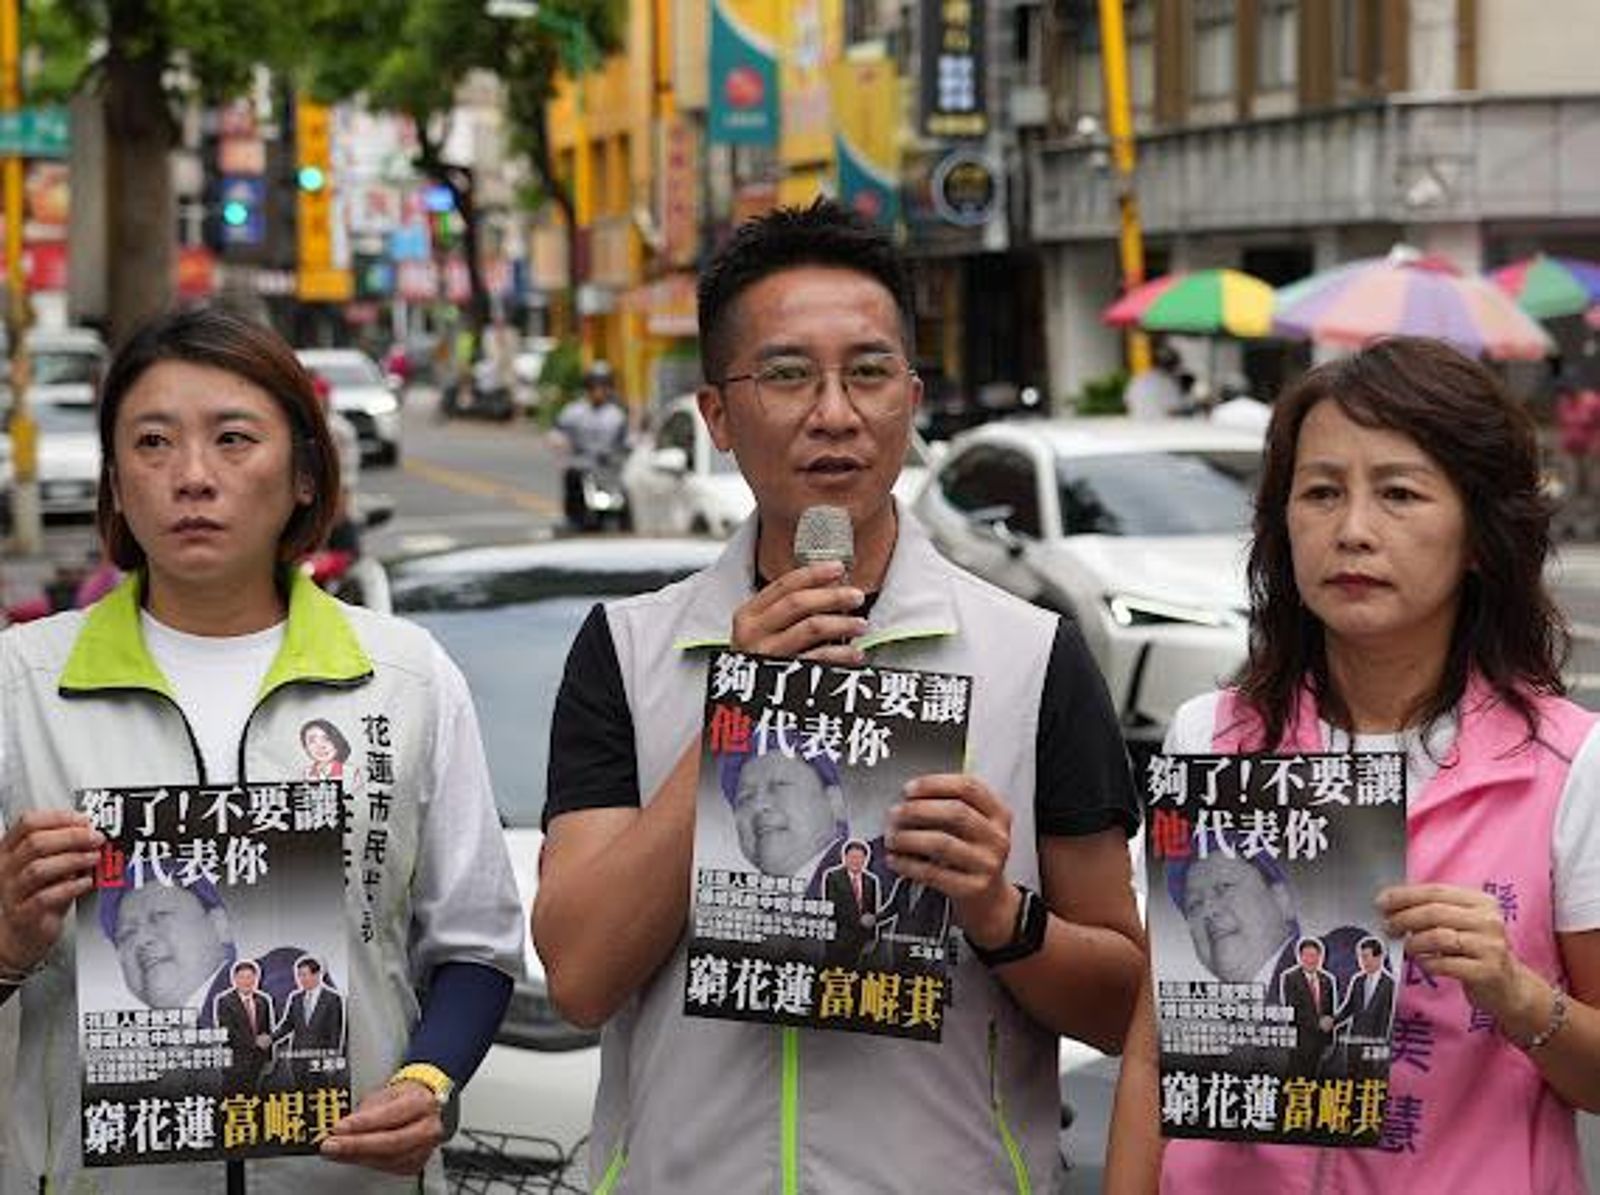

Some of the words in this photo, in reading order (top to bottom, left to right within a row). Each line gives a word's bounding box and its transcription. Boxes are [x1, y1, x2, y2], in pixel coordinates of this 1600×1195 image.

[711, 653, 969, 724] 夠了！不要讓
[710, 703, 893, 767] 他代表你
[1147, 755, 1403, 806] 夠了！不要讓
[1153, 808, 1329, 860] 他代表你
